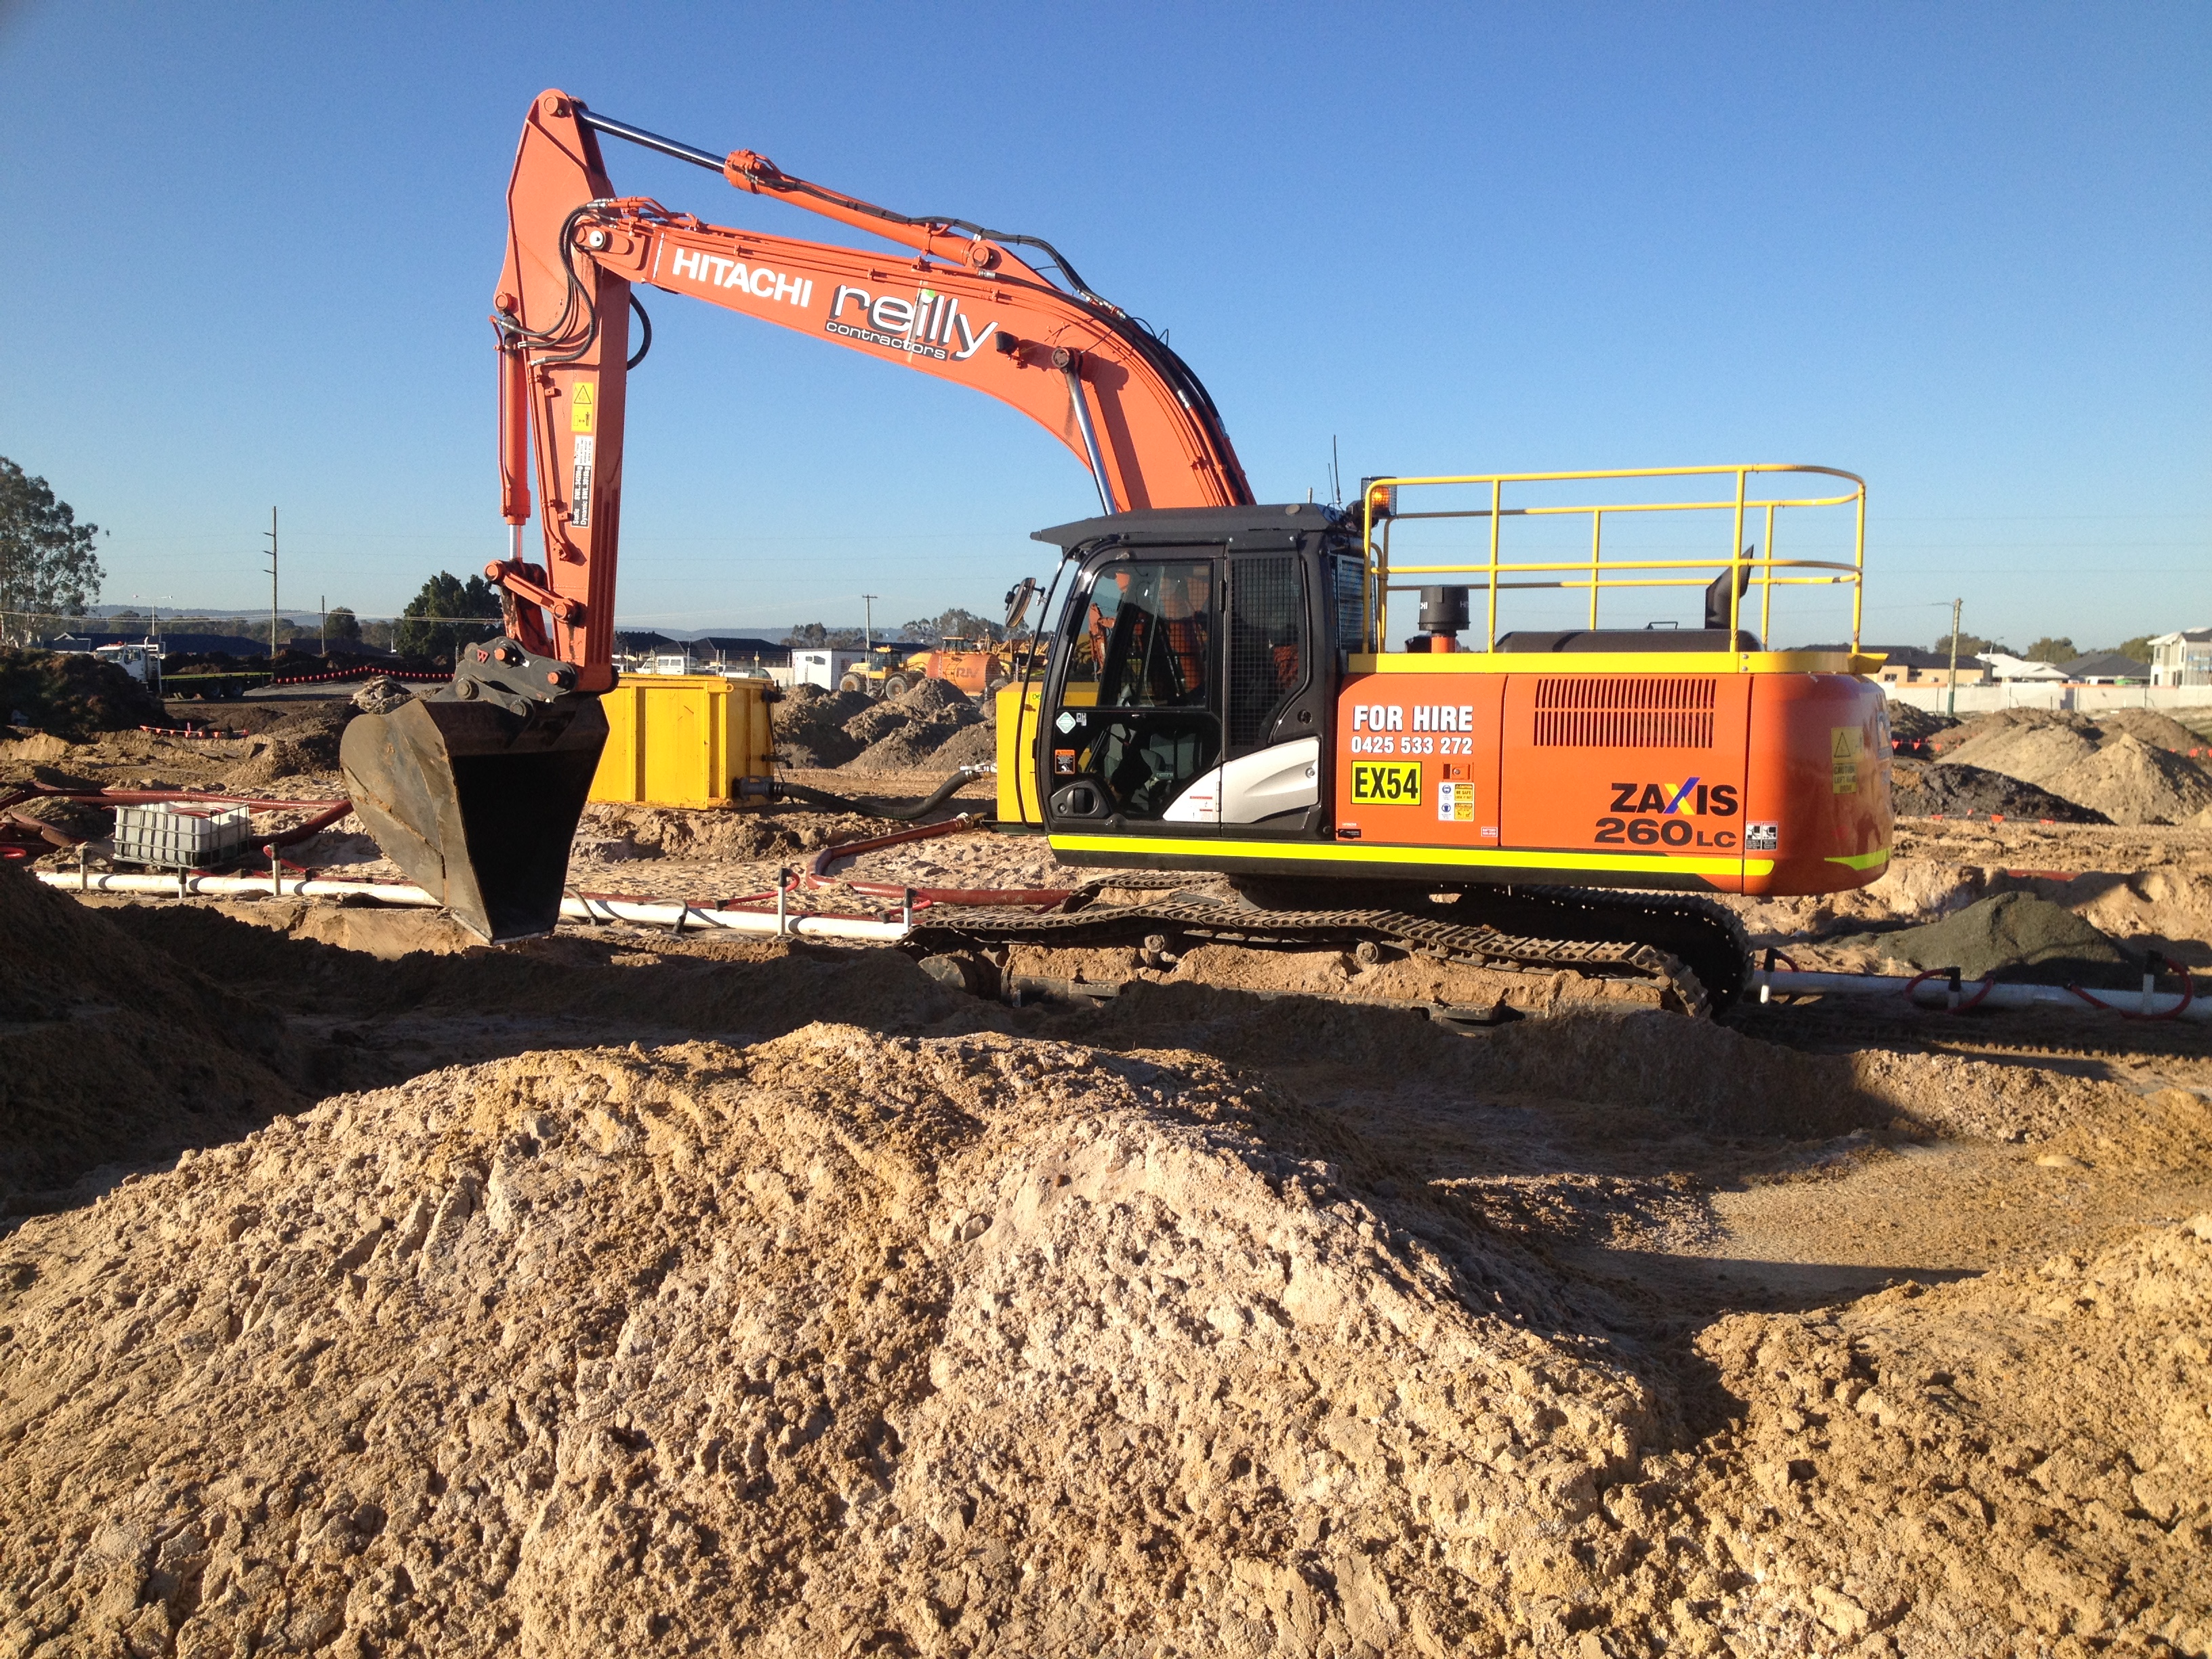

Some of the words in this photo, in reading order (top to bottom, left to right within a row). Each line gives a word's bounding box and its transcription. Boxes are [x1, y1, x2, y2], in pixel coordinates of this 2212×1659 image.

[672, 247, 813, 308] HITACHI
[825, 321, 946, 360] contractors
[830, 285, 999, 361] reilly
[1353, 705, 1404, 732] FOR
[1412, 705, 1473, 733] HIRE
[1351, 735, 1395, 754] 0425
[1400, 736, 1434, 754] 533
[1439, 737, 1473, 754] 272
[1355, 766, 1418, 800] EX54
[1610, 777, 1739, 817] ZAXIS
